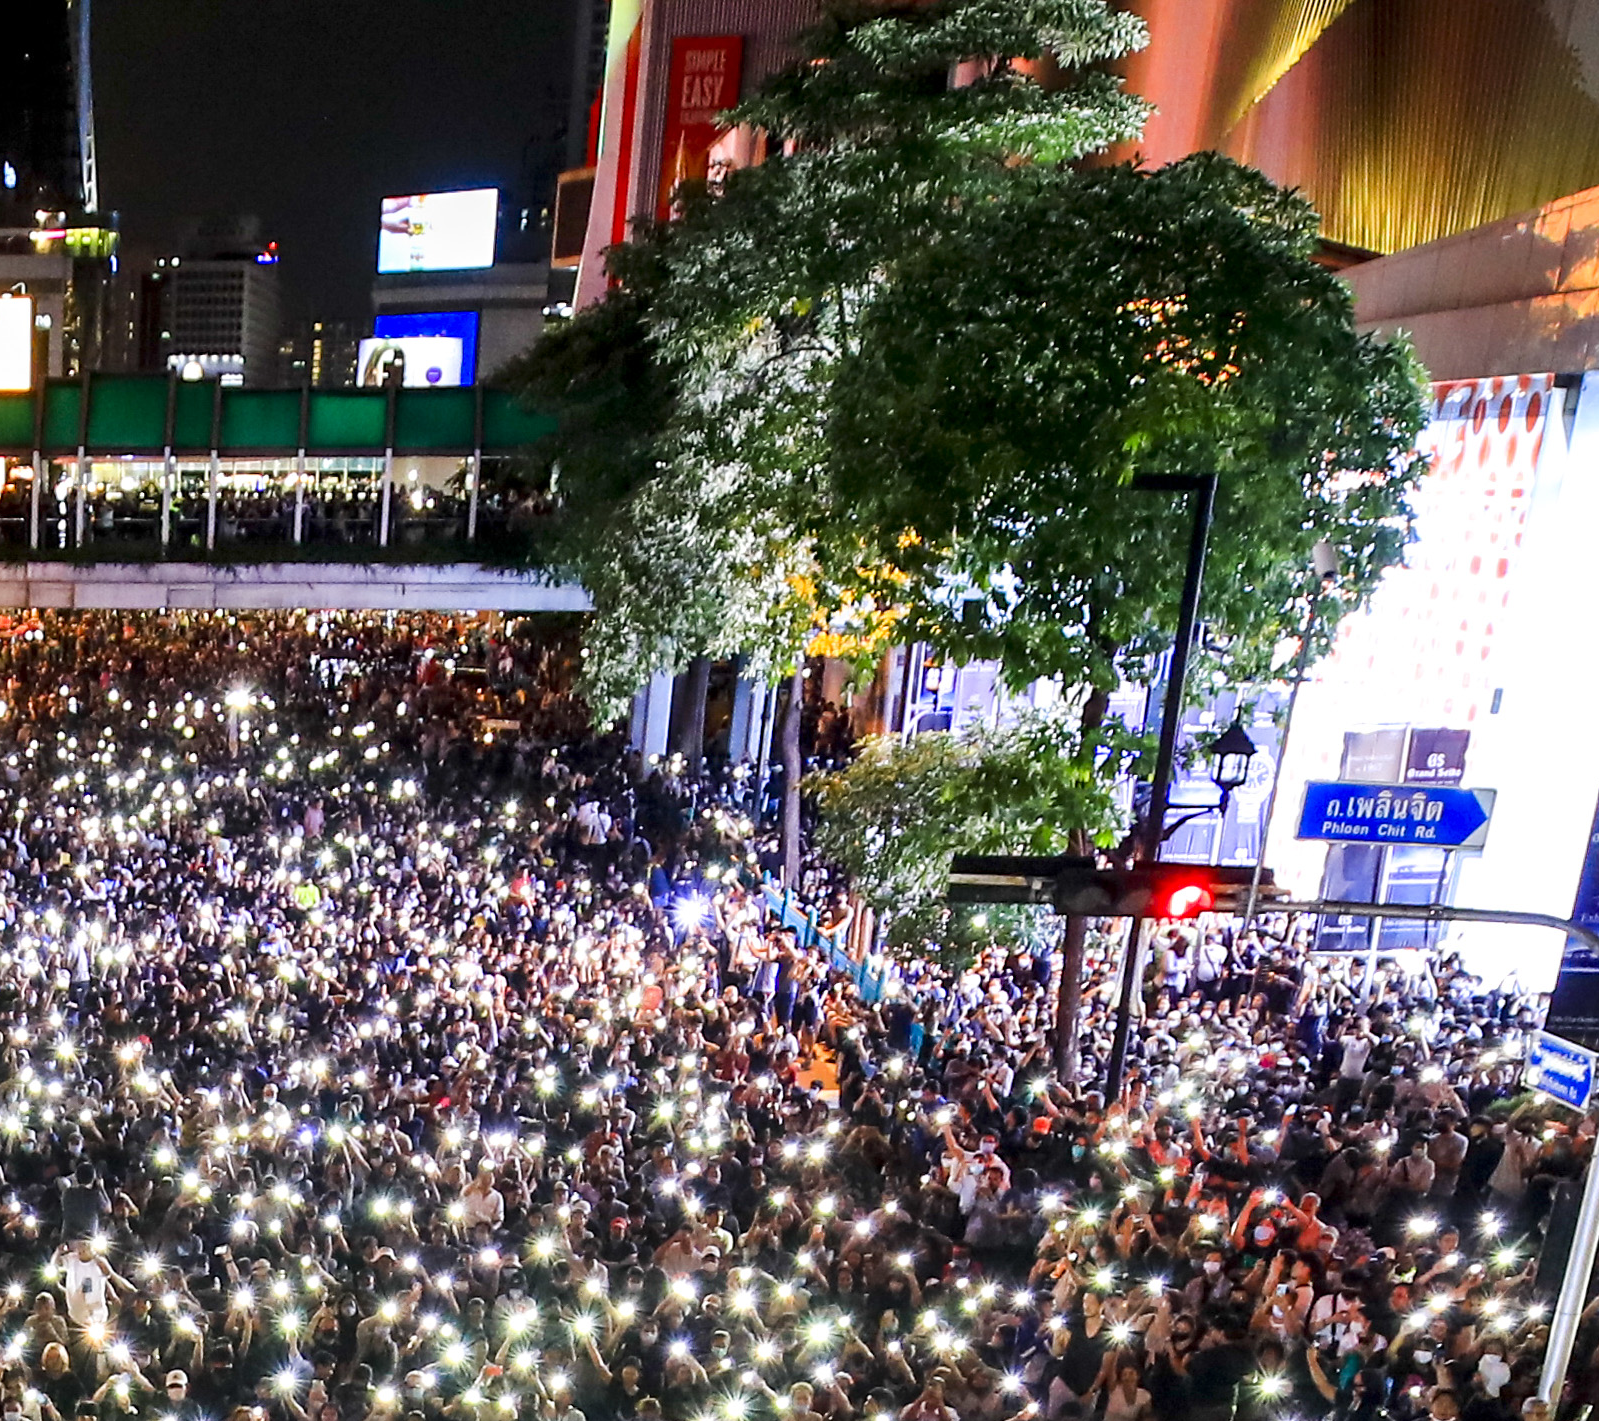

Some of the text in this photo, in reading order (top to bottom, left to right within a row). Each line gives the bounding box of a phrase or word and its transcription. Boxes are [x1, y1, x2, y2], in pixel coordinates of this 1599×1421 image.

[682, 74, 724, 109] EASY
[1326, 790, 1444, 822] ถ.เพลินจิต
[1322, 821, 1437, 839] Phloen Chit Rd.
